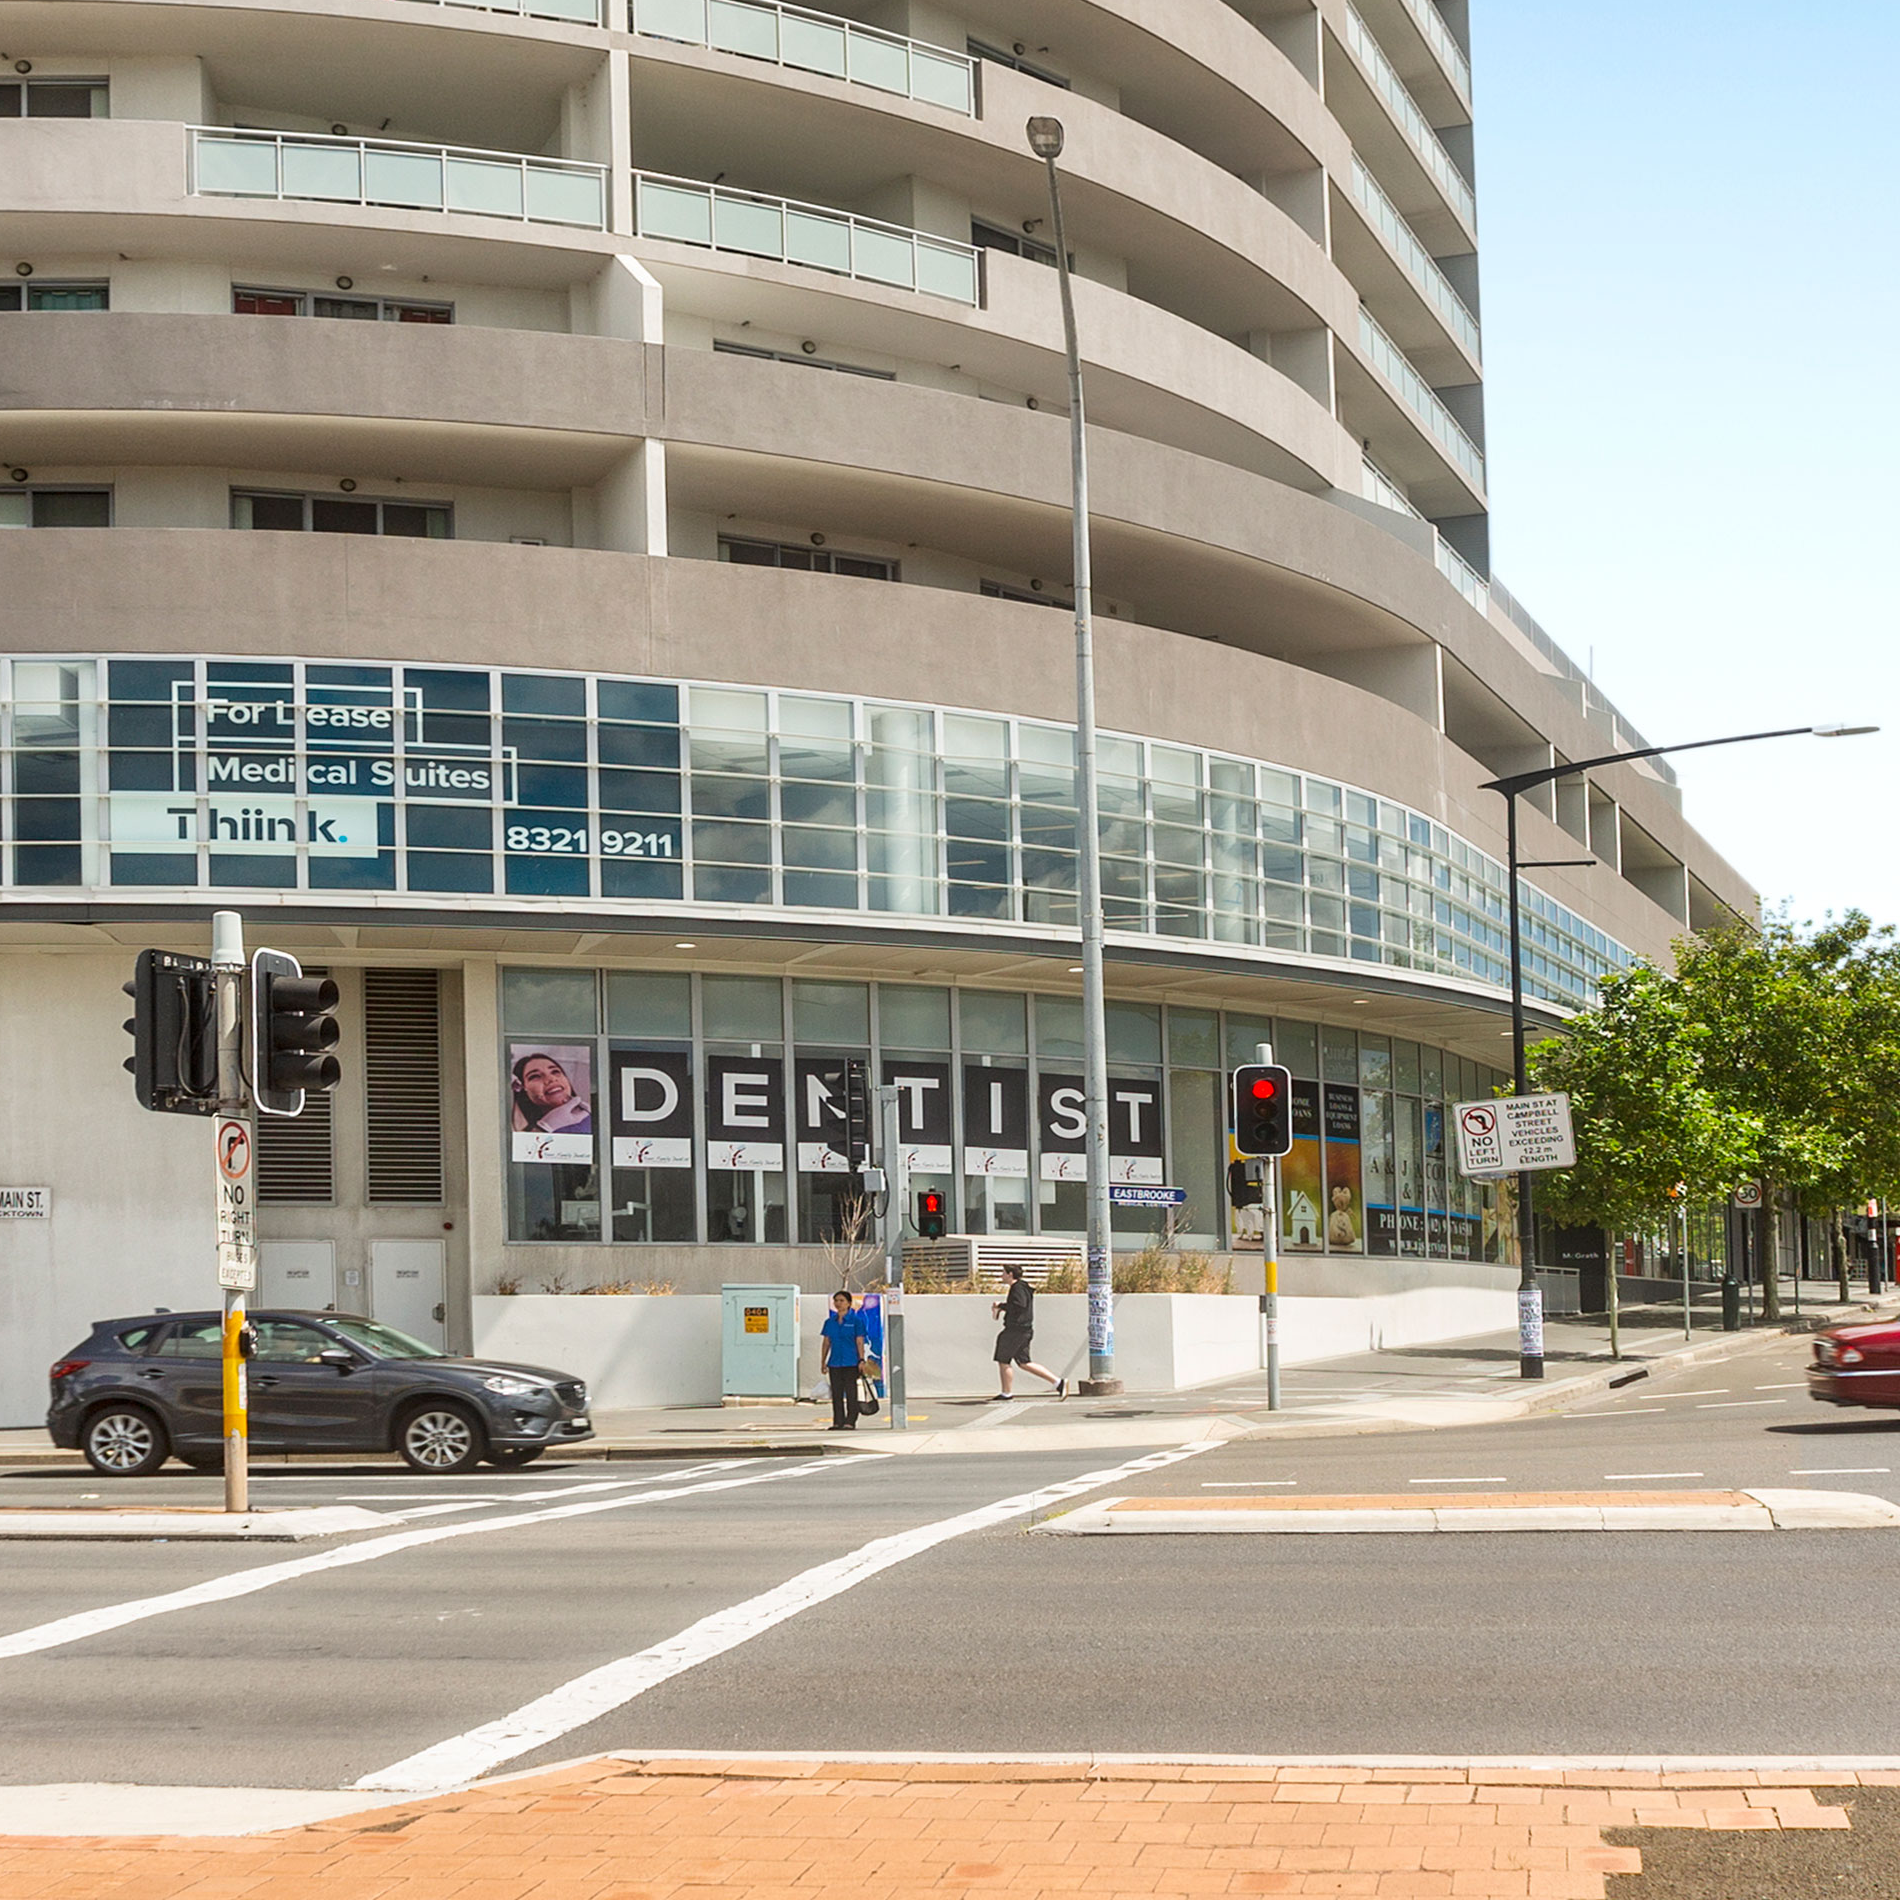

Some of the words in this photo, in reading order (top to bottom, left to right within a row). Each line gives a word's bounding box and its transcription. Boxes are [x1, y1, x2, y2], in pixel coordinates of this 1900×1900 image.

[207, 698, 265, 724] For
[276, 700, 392, 728] Lease
[208, 756, 357, 785] Medical
[370, 761, 490, 790] Suites
[506, 826, 587, 852] 8321
[601, 830, 672, 857] 9211
[1506, 1102, 1530, 1111] MAIN
[1507, 1109, 1559, 1119] CAMPBELL
[1515, 1118, 1552, 1128] STREET
[1512, 1126, 1558, 1137] VEHICLES
[1472, 1136, 1493, 1147] NO
[1509, 1135, 1564, 1147] EXCEEDING
[1470, 1148, 1496, 1156] LEFT
[1524, 1146, 1541, 1154] 12.2
[1470, 1156, 1499, 1165] TURN
[1519, 1154, 1558, 1164] LENGTH
[1370, 1157, 1379, 1173] A
[27, 1191, 43, 1208] ST.
[223, 1185, 245, 1204] NO
[1113, 1189, 1176, 1200] EASTBROOKE
[220, 1210, 250, 1226] RIGHT
[1380, 1214, 1424, 1231] PHONE:
[221, 1230, 249, 1244] TURN
